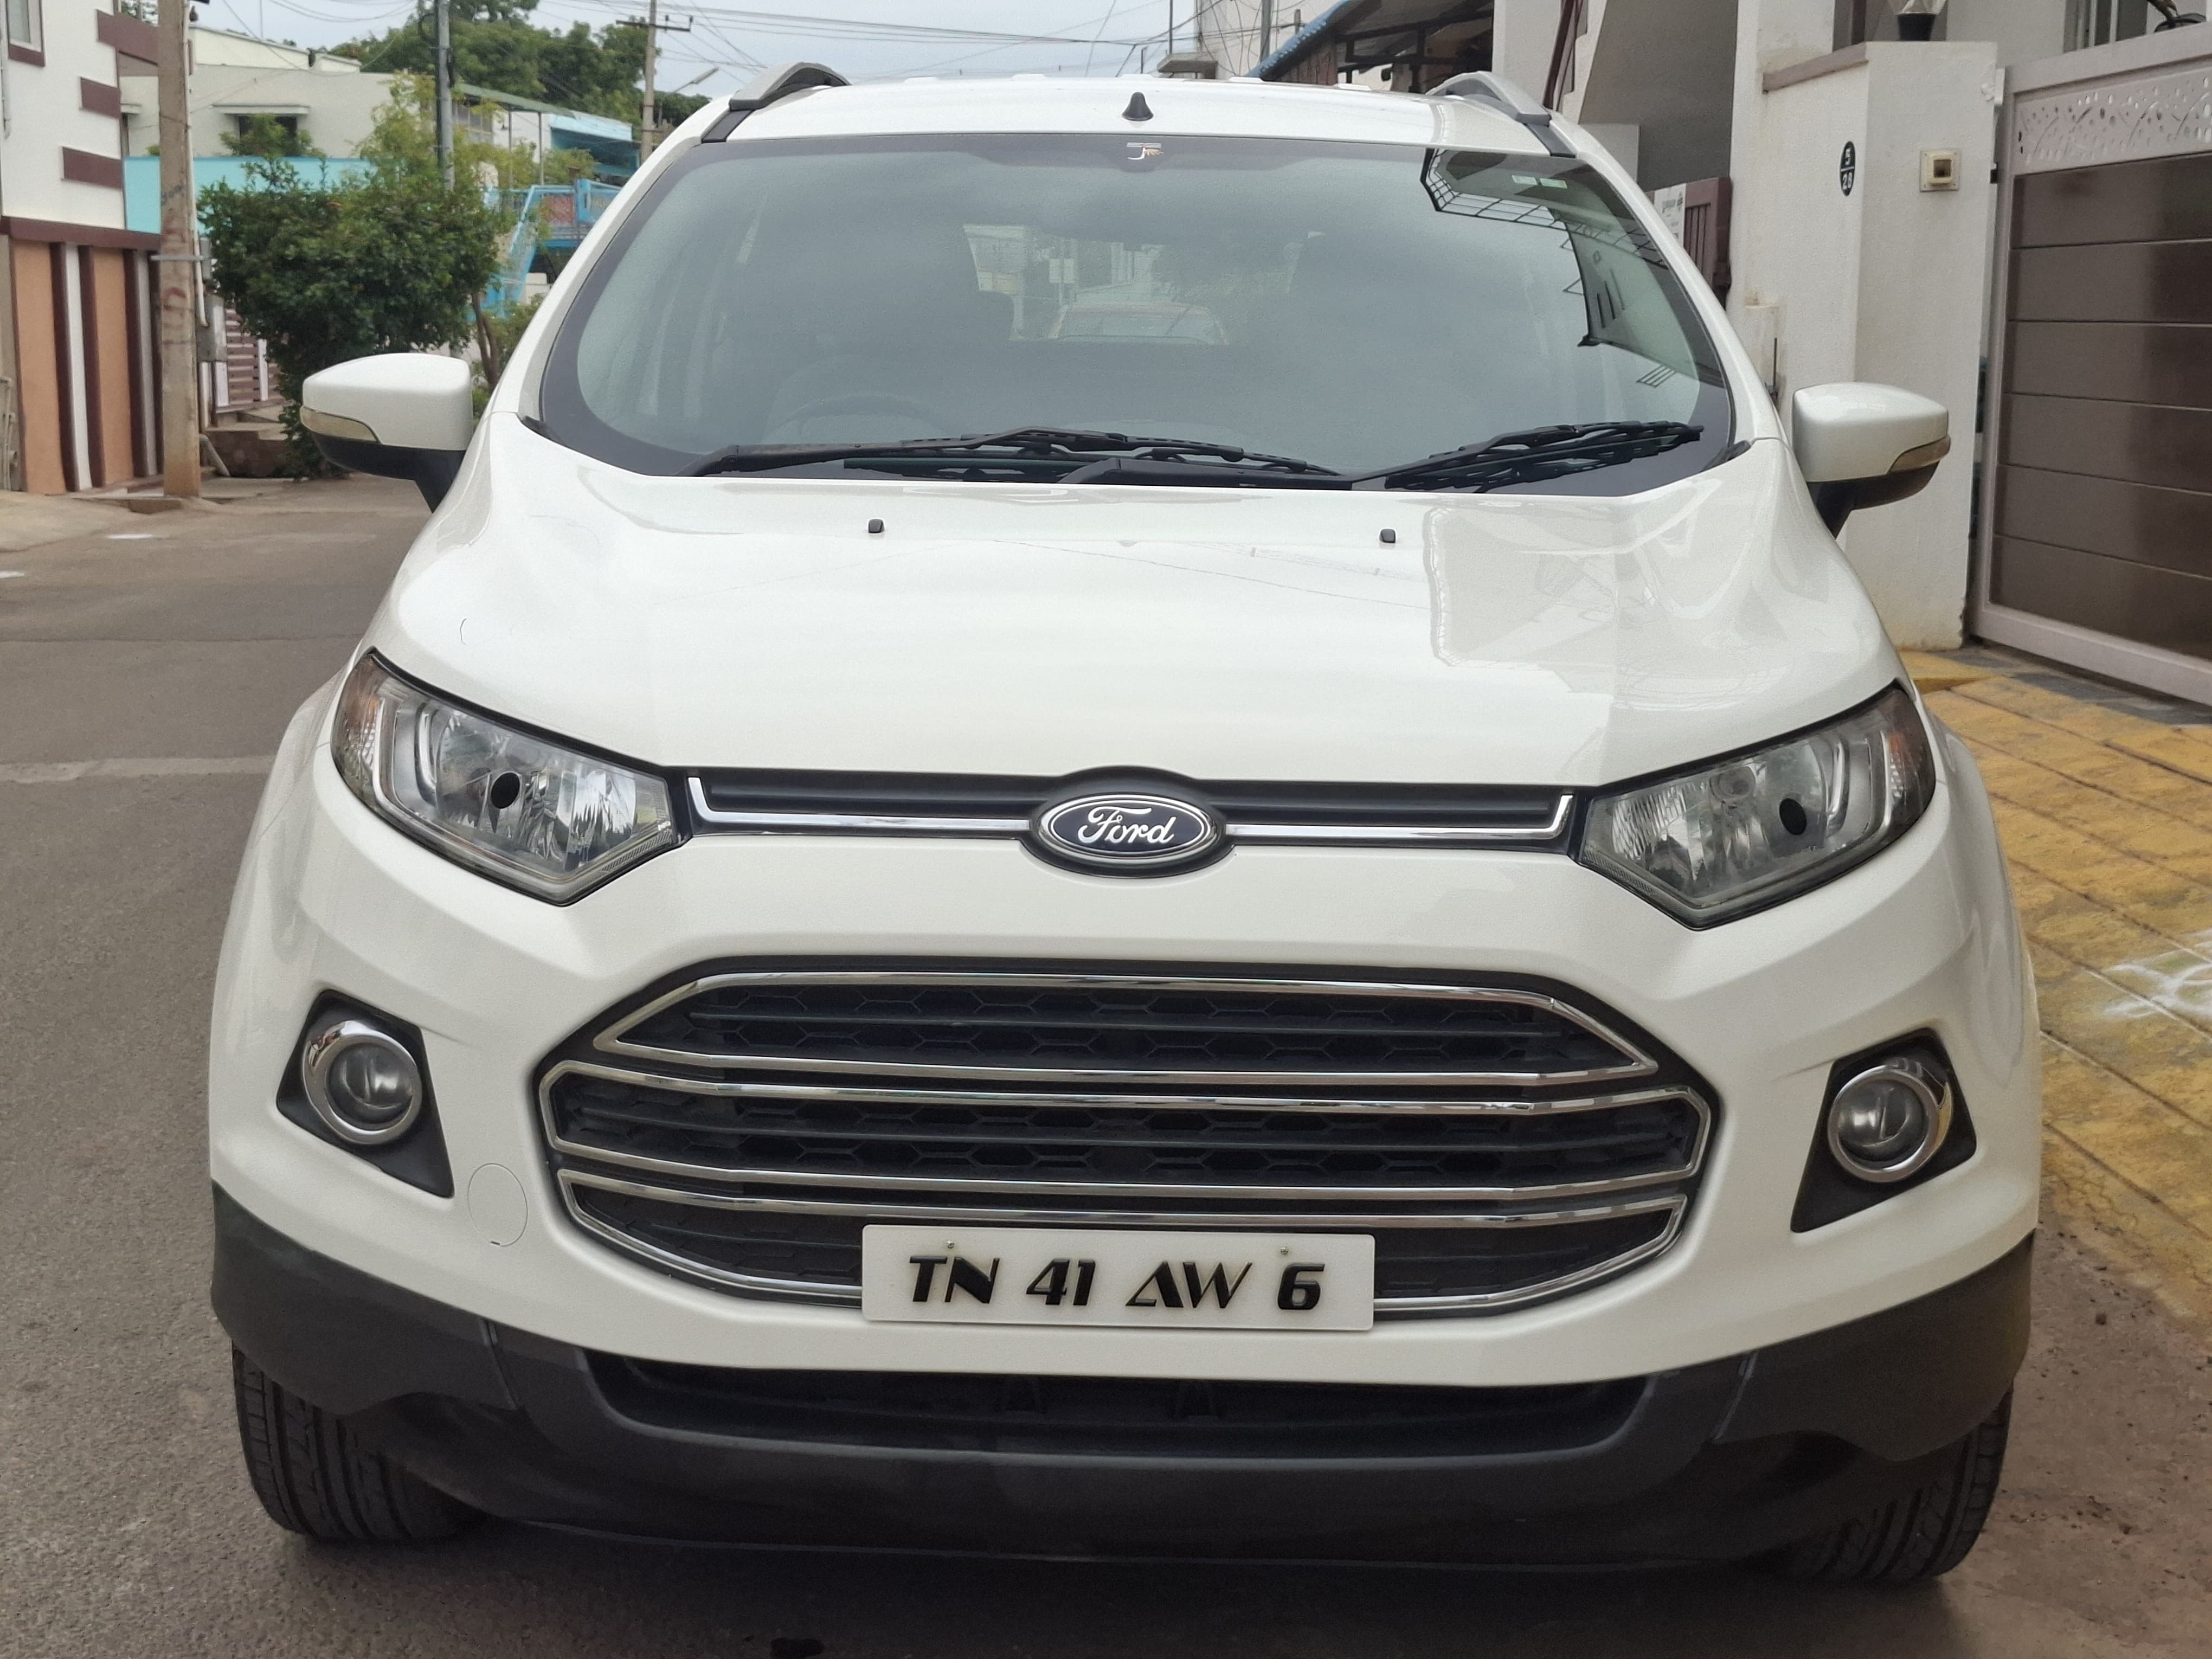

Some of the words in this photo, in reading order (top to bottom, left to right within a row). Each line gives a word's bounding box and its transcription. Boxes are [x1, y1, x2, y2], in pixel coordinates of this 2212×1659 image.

[1845, 147, 1851, 165] 5
[1078, 806, 1176, 844] Ford
[909, 1256, 1000, 1304] TN
[1026, 1259, 1096, 1306] 41
[1125, 1262, 1253, 1309] AW
[1277, 1263, 1325, 1310] 6
